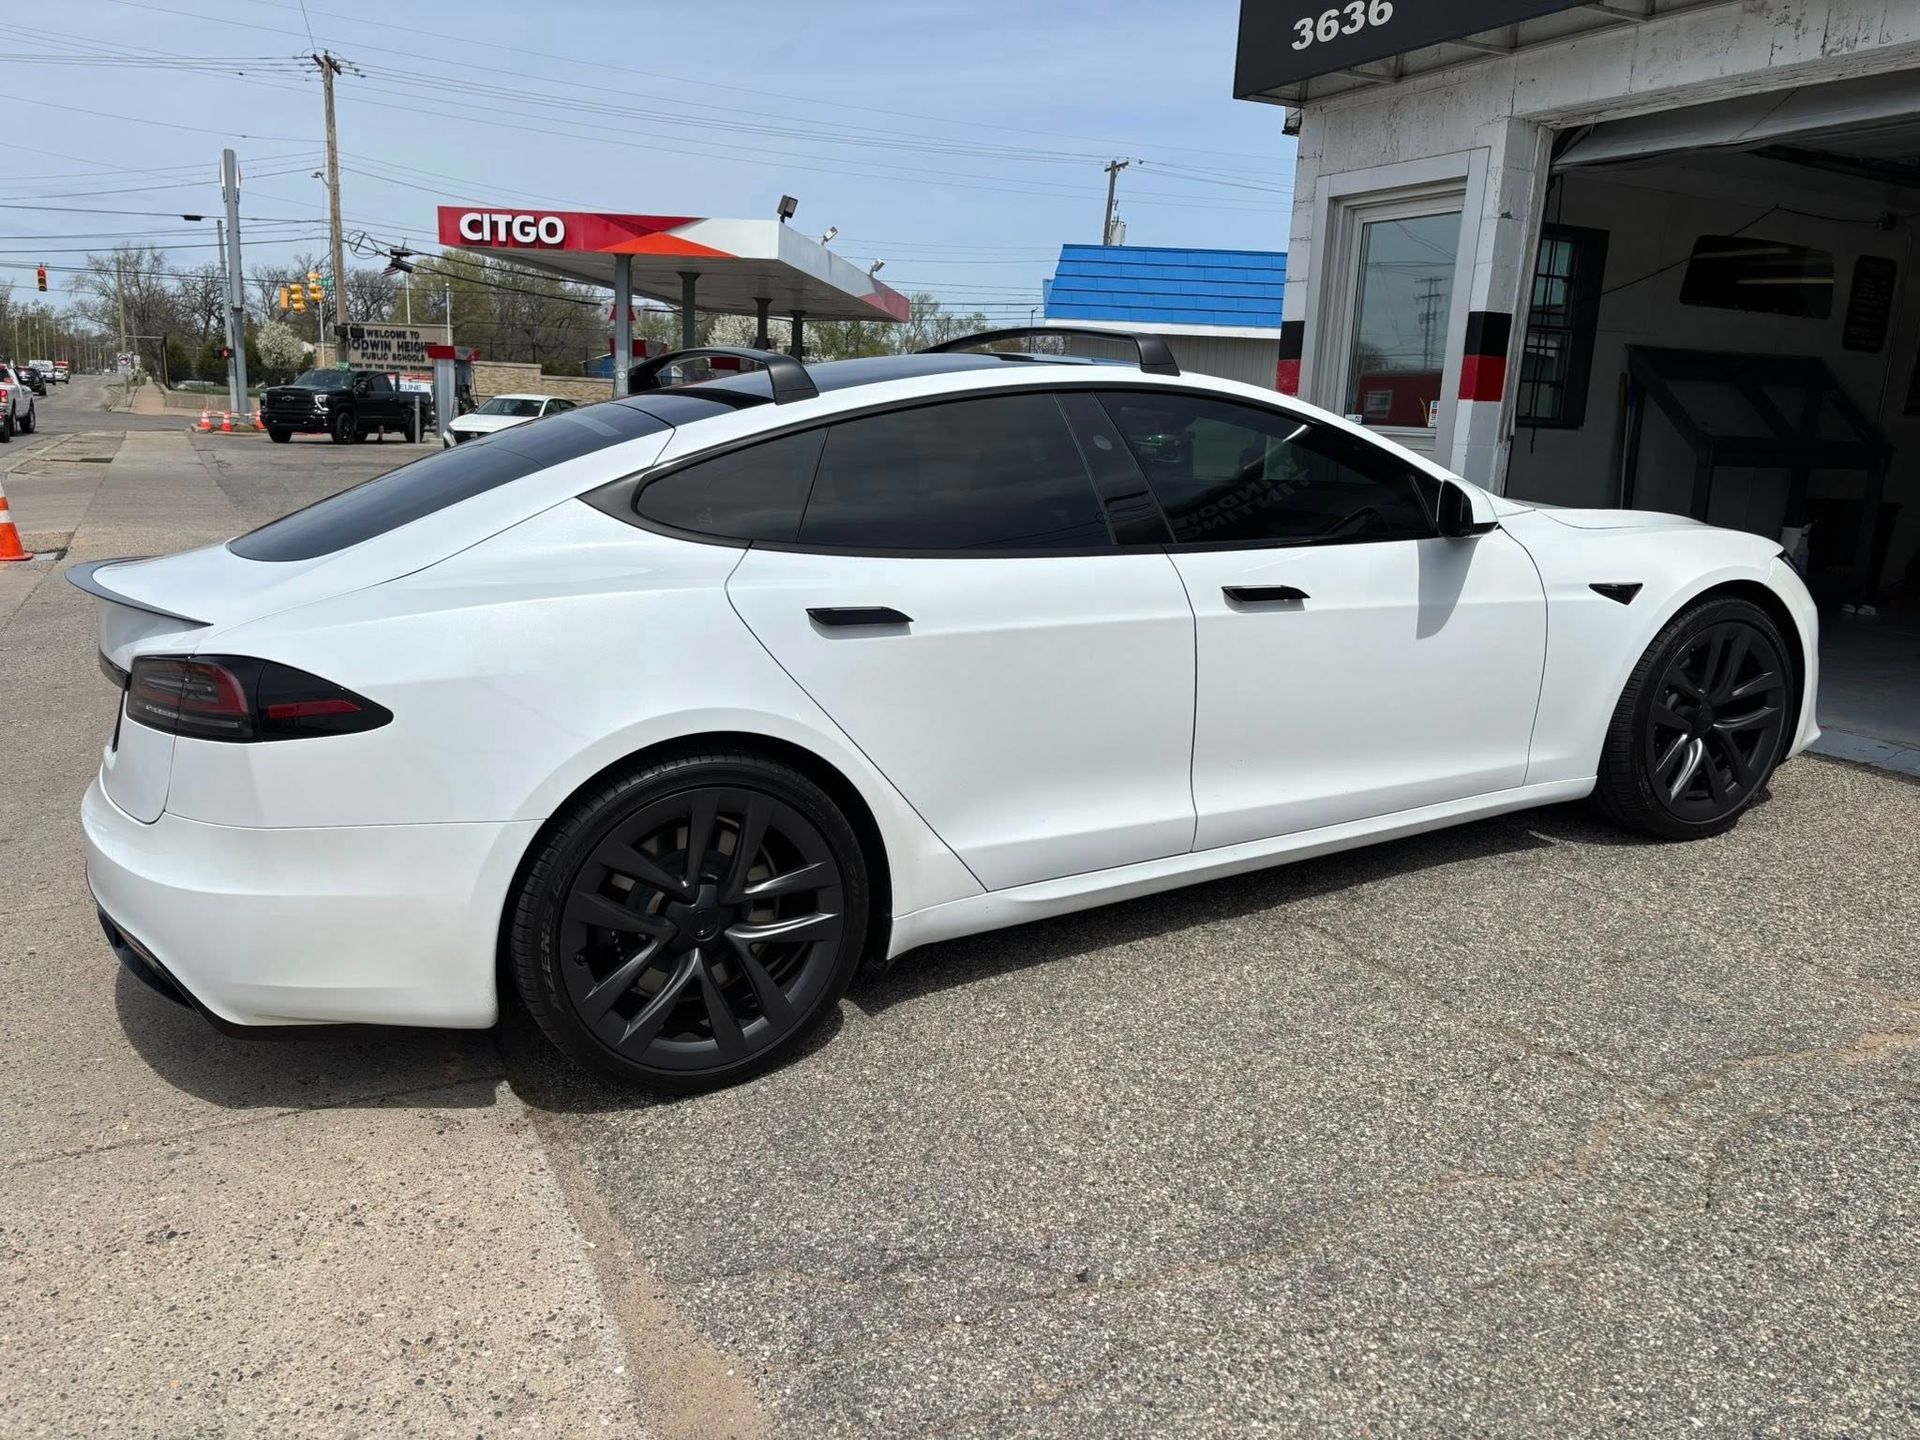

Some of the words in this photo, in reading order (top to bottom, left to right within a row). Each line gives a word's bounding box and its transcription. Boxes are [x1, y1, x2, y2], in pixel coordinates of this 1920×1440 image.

[1291, 0, 1393, 50] 3636
[459, 212, 566, 245] CITGO
[366, 329, 407, 339] WELCOME
[410, 331, 420, 340] TO
[348, 339, 391, 352] ODWIN
[397, 341, 438, 353] HEIGH
[361, 352, 388, 360] PUBLIC
[392, 353, 426, 363] SCHOOLS
